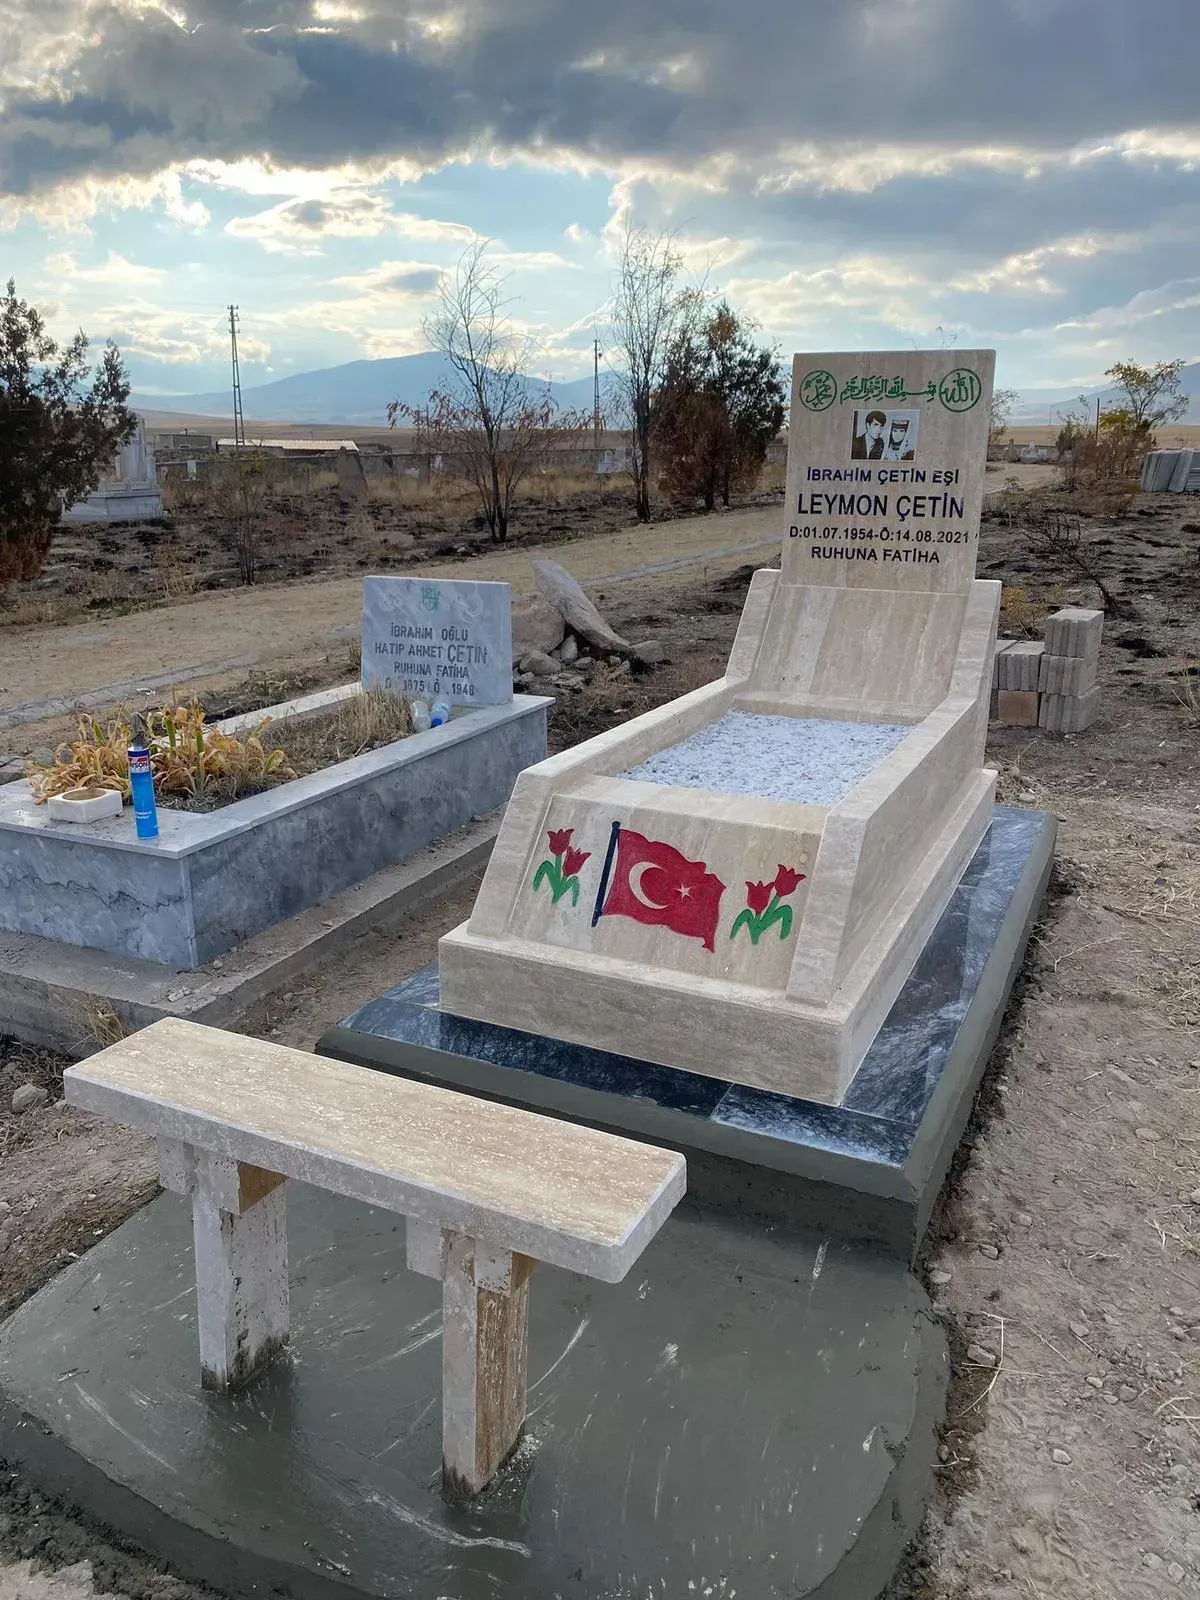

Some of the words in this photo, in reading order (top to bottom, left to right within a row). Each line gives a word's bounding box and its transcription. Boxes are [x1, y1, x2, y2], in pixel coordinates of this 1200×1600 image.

[807, 466, 871, 482] İBRAHİM
[878, 469, 926, 485] ÇETİN
[932, 469, 959, 486] EŞİ
[797, 493, 888, 516] LEYMON
[896, 492, 965, 521] ÇETİN
[811, 546, 878, 561] RUHUNA
[883, 548, 940, 563] FATİHA
[391, 622, 432, 640] İBRAHİM
[441, 626, 468, 641] OĞLU
[408, 644, 442, 659] AHMET
[447, 643, 487, 665] ÇETİN
[394, 661, 432, 676] RUHUNA
[436, 664, 469, 679] FATİHA
